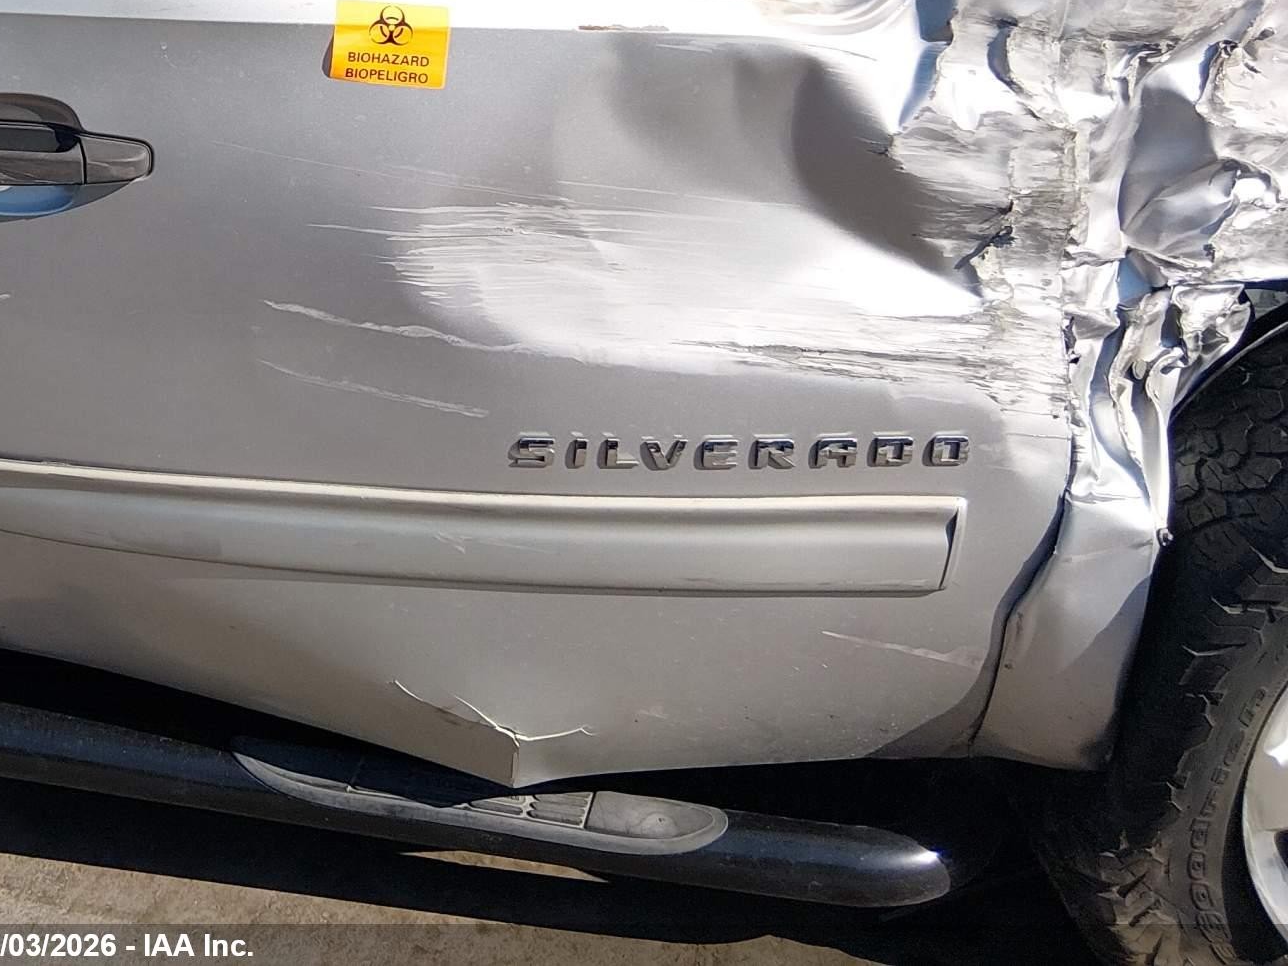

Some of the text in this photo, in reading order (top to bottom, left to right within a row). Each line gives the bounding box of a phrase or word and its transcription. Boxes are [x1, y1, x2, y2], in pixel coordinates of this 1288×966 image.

[347, 51, 430, 68] BIOHAZARD
[344, 67, 429, 84] BIOPELIGRO
[509, 431, 970, 470] SILVERADO
